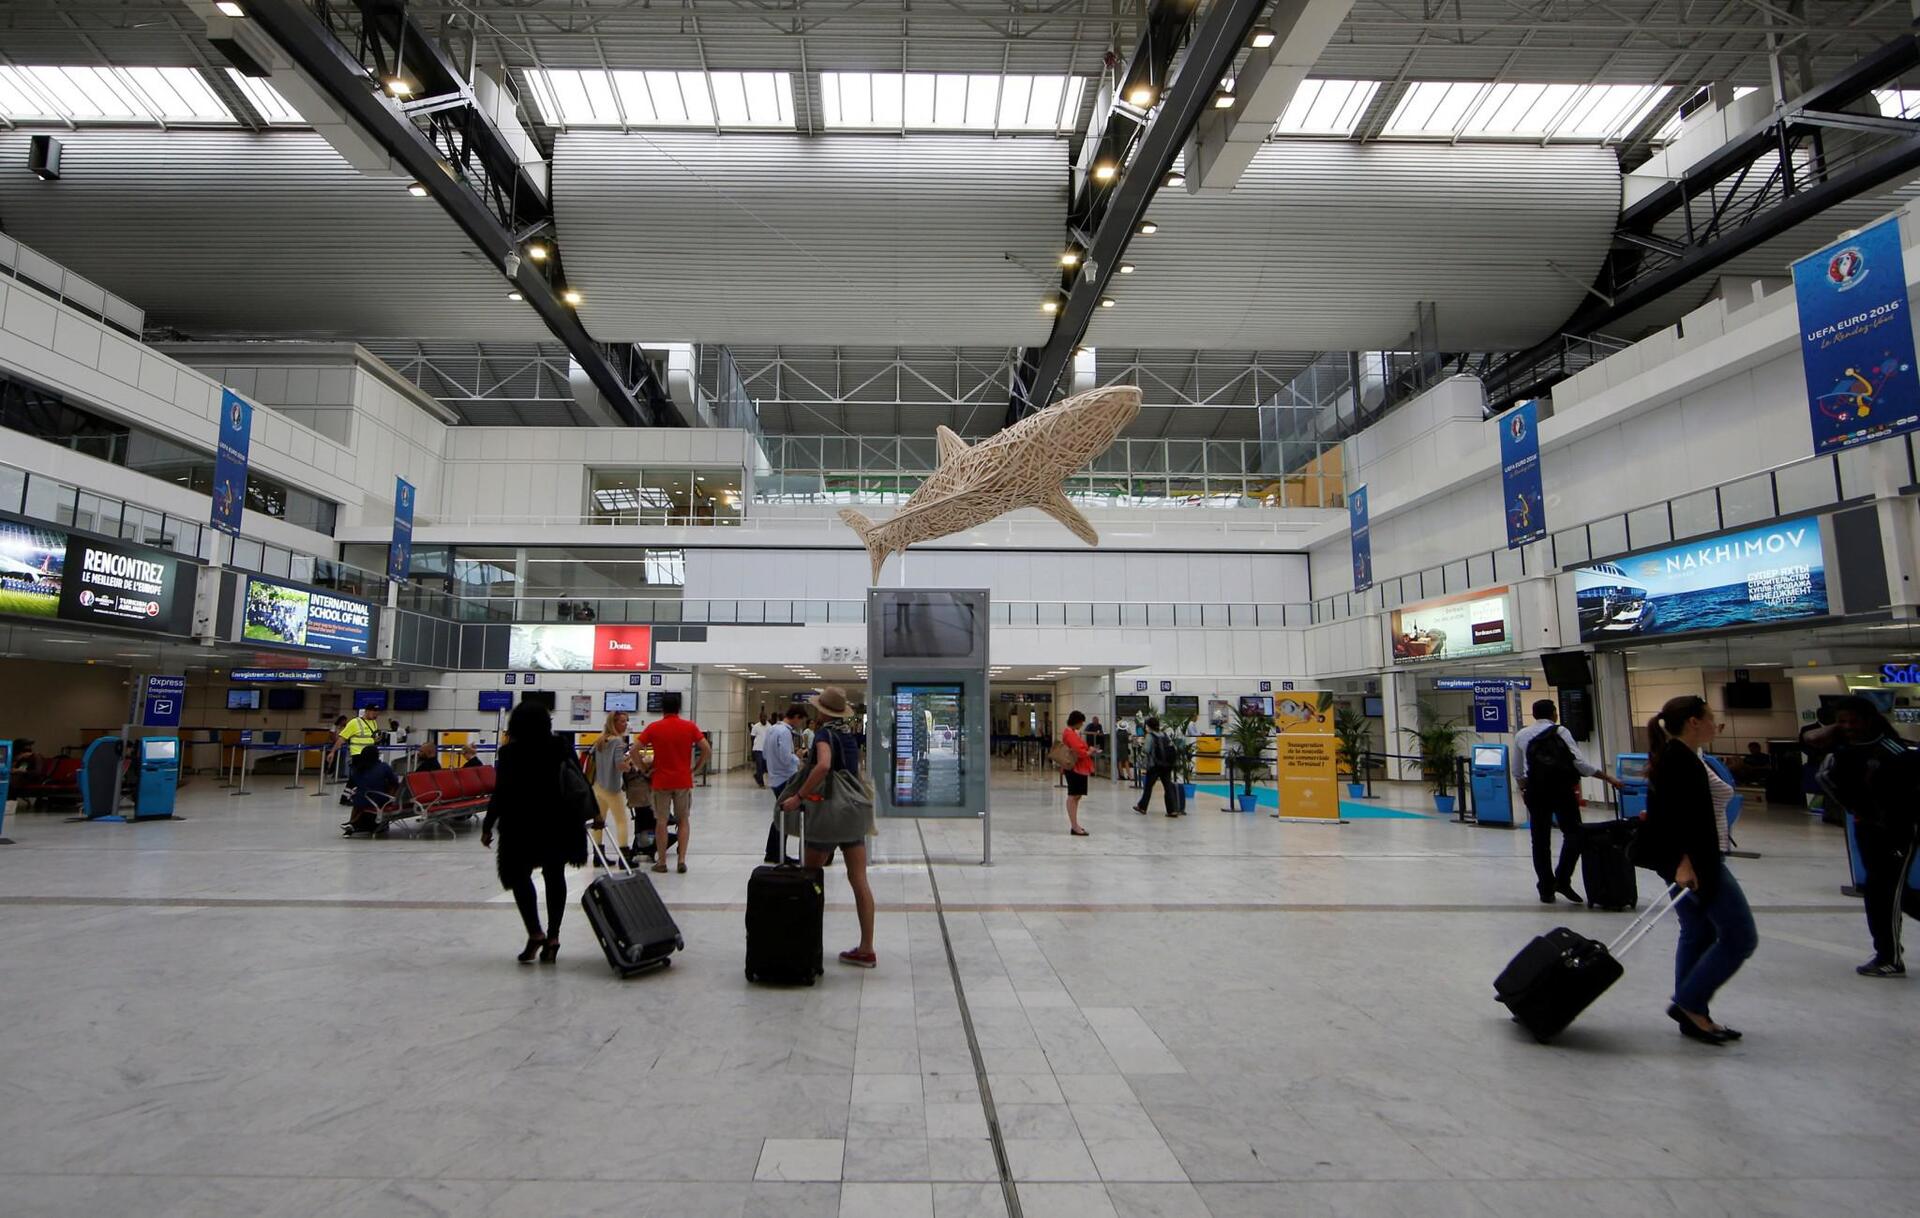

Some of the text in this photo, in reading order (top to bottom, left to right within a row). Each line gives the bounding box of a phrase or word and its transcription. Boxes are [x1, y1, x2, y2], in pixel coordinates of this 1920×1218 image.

[1807, 300, 1900, 341] UEFA EURO 2016
[1820, 339, 1832, 349] Le
[1666, 528, 1805, 573] NAKHIMOV
[83, 548, 165, 584] RENCONTREZ
[1747, 564, 1810, 581] СУПЕР ЯХТЫ
[82, 571, 162, 596] LE MEILLEUR DE L'EUROPE
[1748, 573, 1810, 588] СТРОИТЕЛЬСТВО
[1748, 580, 1812, 595] КУПЛЯ-ПРОДАЖА
[1749, 586, 1812, 602] МЕНЕДЖМЕНТ
[1764, 596, 1797, 607] ЧАРТЕР
[310, 593, 369, 615] INTERNATIONAL
[309, 606, 342, 622] SCHOOL
[342, 613, 351, 624] OF
[352, 615, 369, 627] NICE
[820, 646, 866, 662] DEPA
[150, 677, 184, 687] express
[1474, 685, 1505, 694] express
